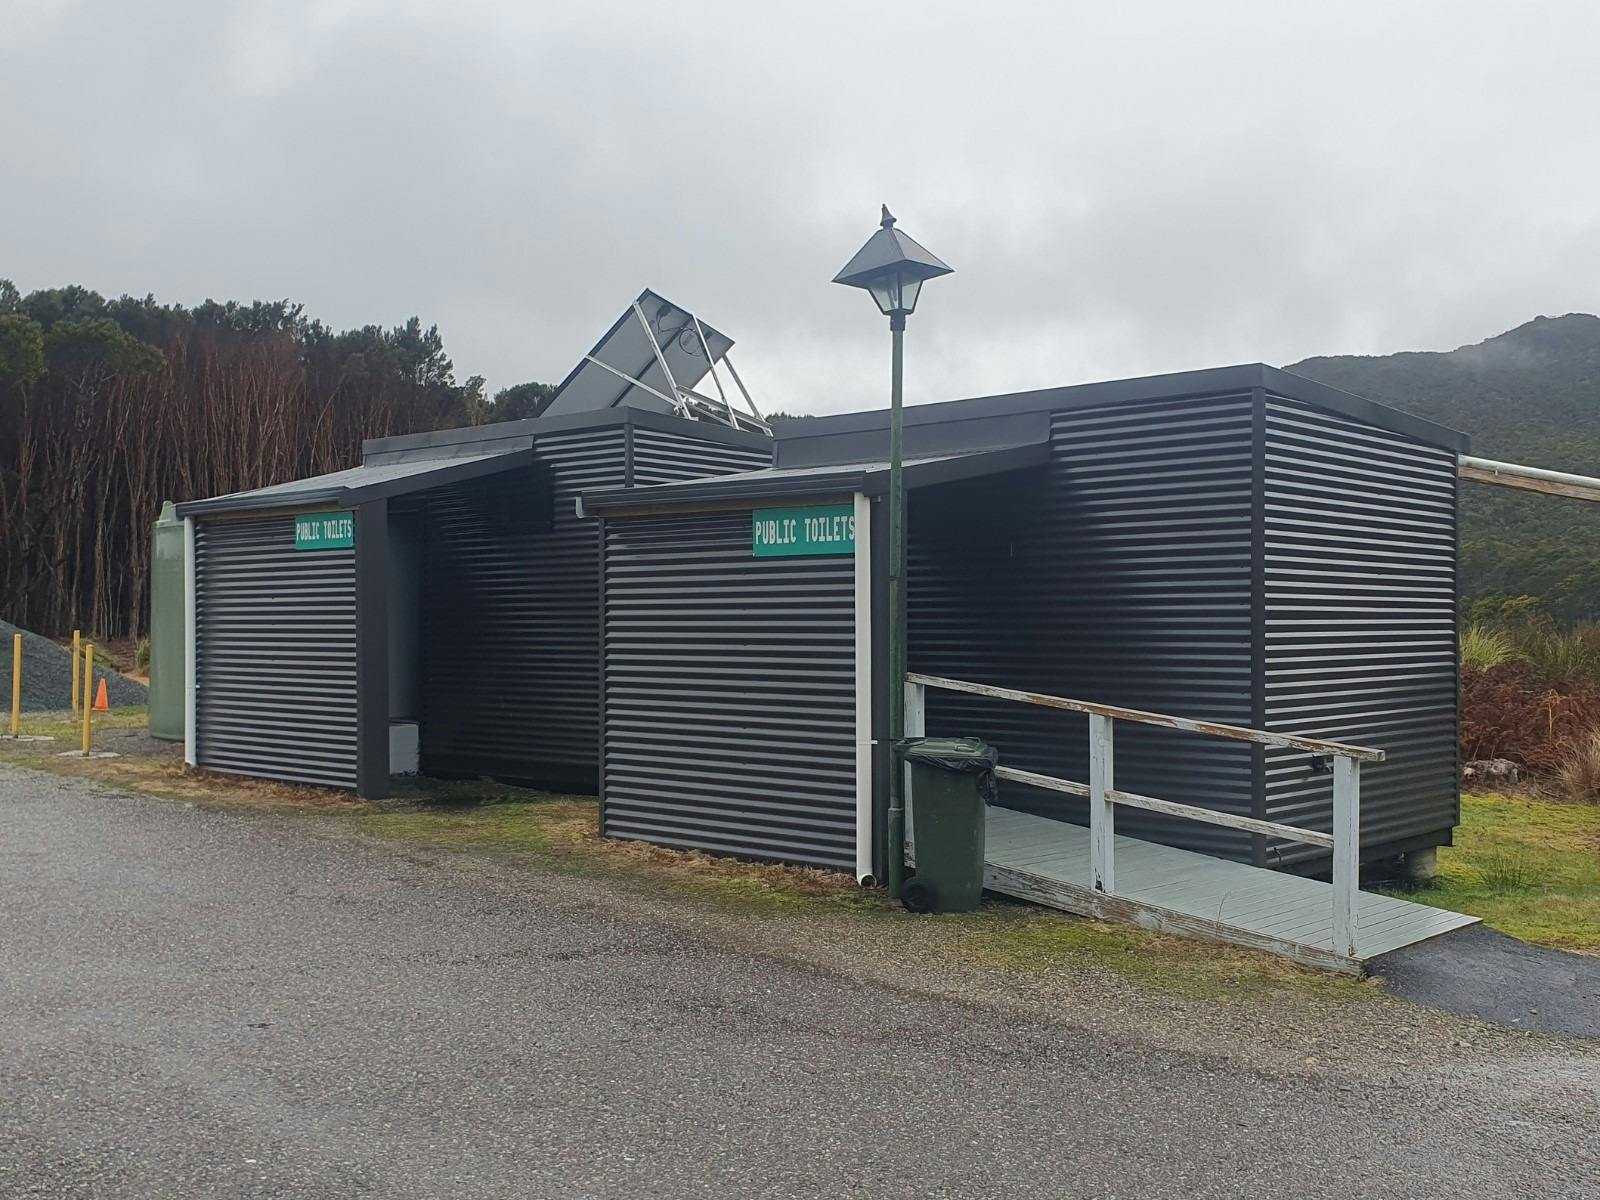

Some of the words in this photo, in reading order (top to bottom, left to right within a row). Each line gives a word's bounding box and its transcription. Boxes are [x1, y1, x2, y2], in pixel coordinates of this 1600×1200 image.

[297, 521, 319, 541] PUBLIC
[324, 519, 351, 540] TOILETS
[755, 519, 797, 544] PUBLIC
[804, 515, 855, 542] TOILETS
